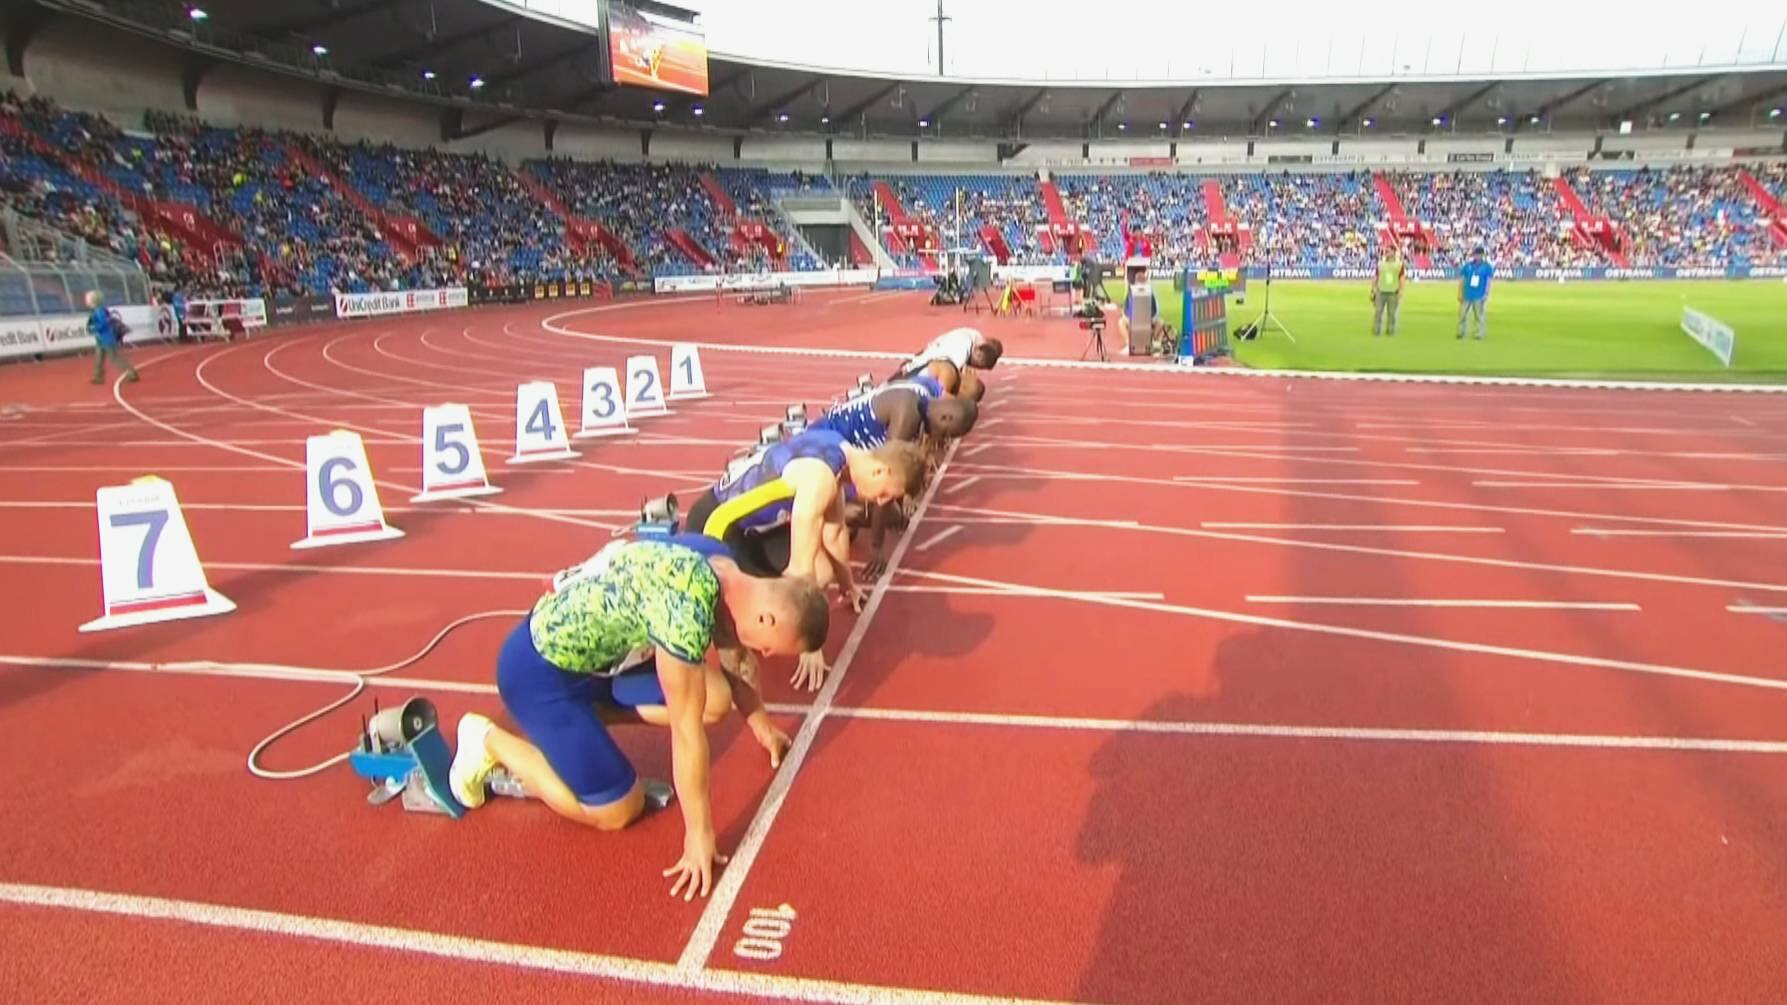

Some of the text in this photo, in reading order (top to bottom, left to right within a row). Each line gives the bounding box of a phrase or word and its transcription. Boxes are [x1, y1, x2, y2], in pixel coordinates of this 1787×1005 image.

[633, 369, 656, 402] 2
[679, 355, 693, 385] 1
[525, 398, 556, 441] 4
[591, 381, 616, 418] 3
[435, 423, 470, 475] 5
[318, 456, 363, 516] 6
[109, 510, 169, 590] 7
[733, 903, 797, 960] 100
